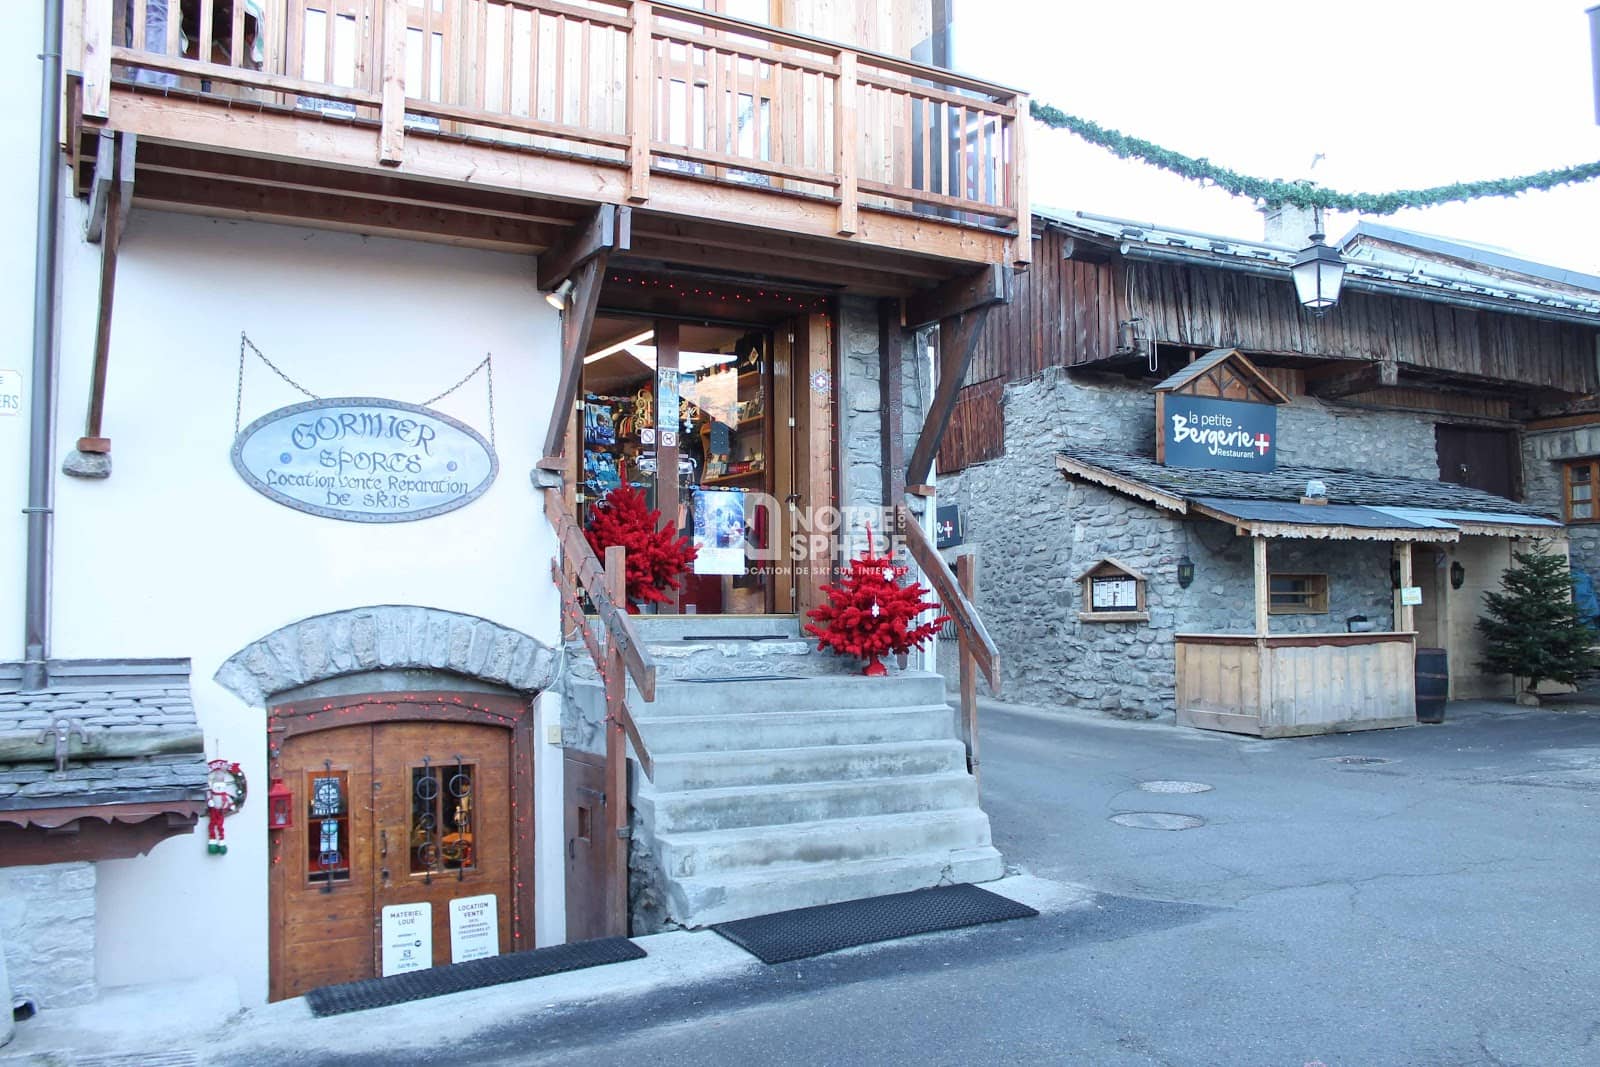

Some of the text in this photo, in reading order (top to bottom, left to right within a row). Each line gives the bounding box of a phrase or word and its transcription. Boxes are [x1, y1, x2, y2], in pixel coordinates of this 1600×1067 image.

[1189, 411, 1233, 428] la petite
[291, 412, 436, 457] GORMIER
[1171, 414, 1255, 456] Bergerie
[319, 446, 422, 474] SPORTS
[1217, 448, 1254, 459] Restaurant
[266, 468, 335, 489] Location
[458, 902, 489, 911] LOCATION
